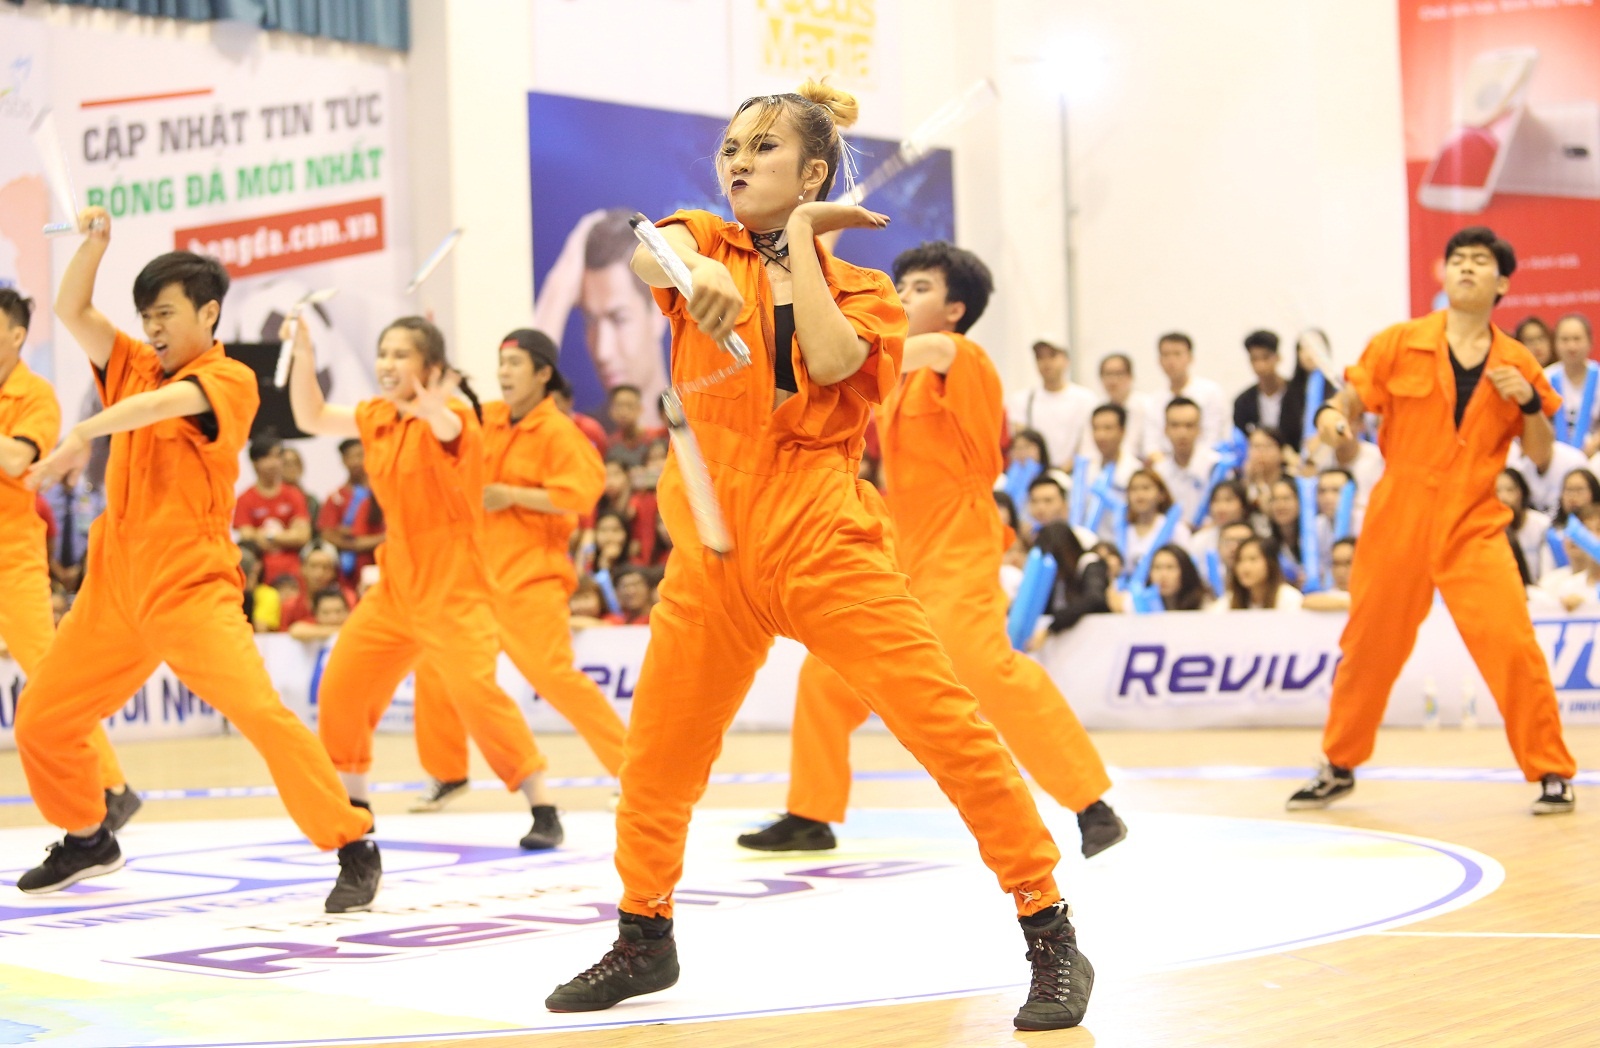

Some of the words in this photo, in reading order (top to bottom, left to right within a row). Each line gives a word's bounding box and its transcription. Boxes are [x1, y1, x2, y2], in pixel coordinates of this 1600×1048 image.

[83, 114, 146, 171] CẬP
[158, 103, 248, 158] NHẬT
[260, 101, 314, 140] TIN
[186, 163, 227, 209] ĐÁ
[304, 136, 384, 191] NHẤT
[1118, 645, 1341, 697] Reviv
